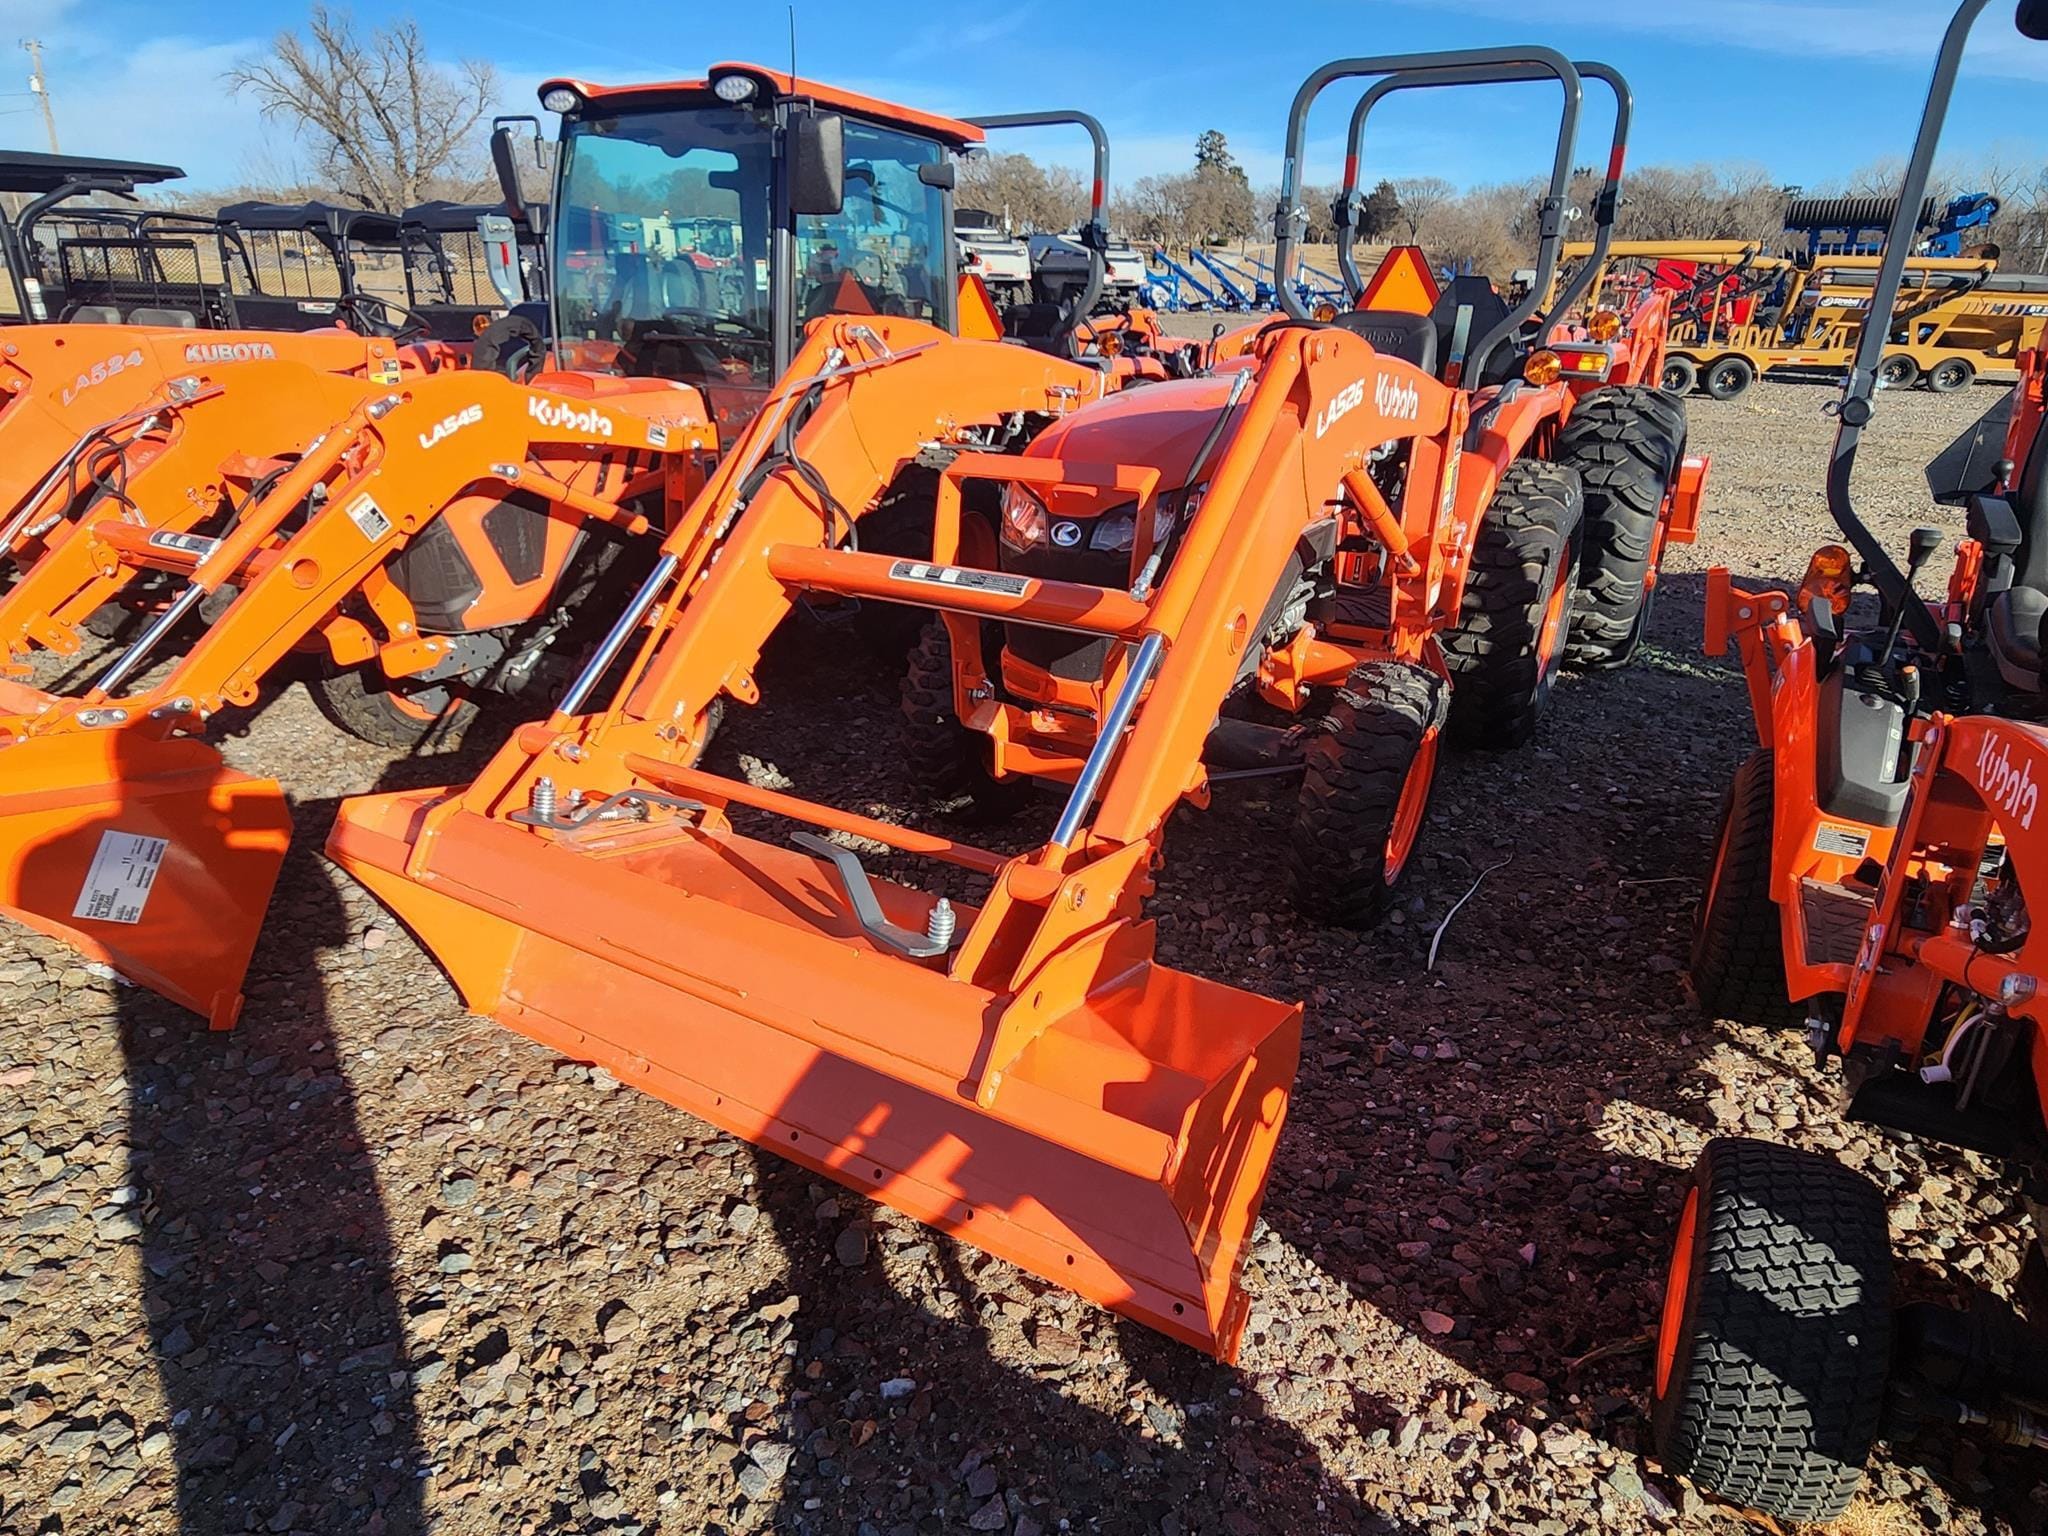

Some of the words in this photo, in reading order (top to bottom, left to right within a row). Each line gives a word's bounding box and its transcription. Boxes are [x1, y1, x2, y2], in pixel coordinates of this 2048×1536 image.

[62, 348, 144, 405] LA524
[185, 343, 277, 363] KUBOTA
[528, 396, 613, 437] Kubota
[1316, 378, 1366, 440] LA526
[1375, 372, 1419, 420] Kubota
[419, 404, 484, 449] LA545
[1976, 728, 2039, 831] Kubota
